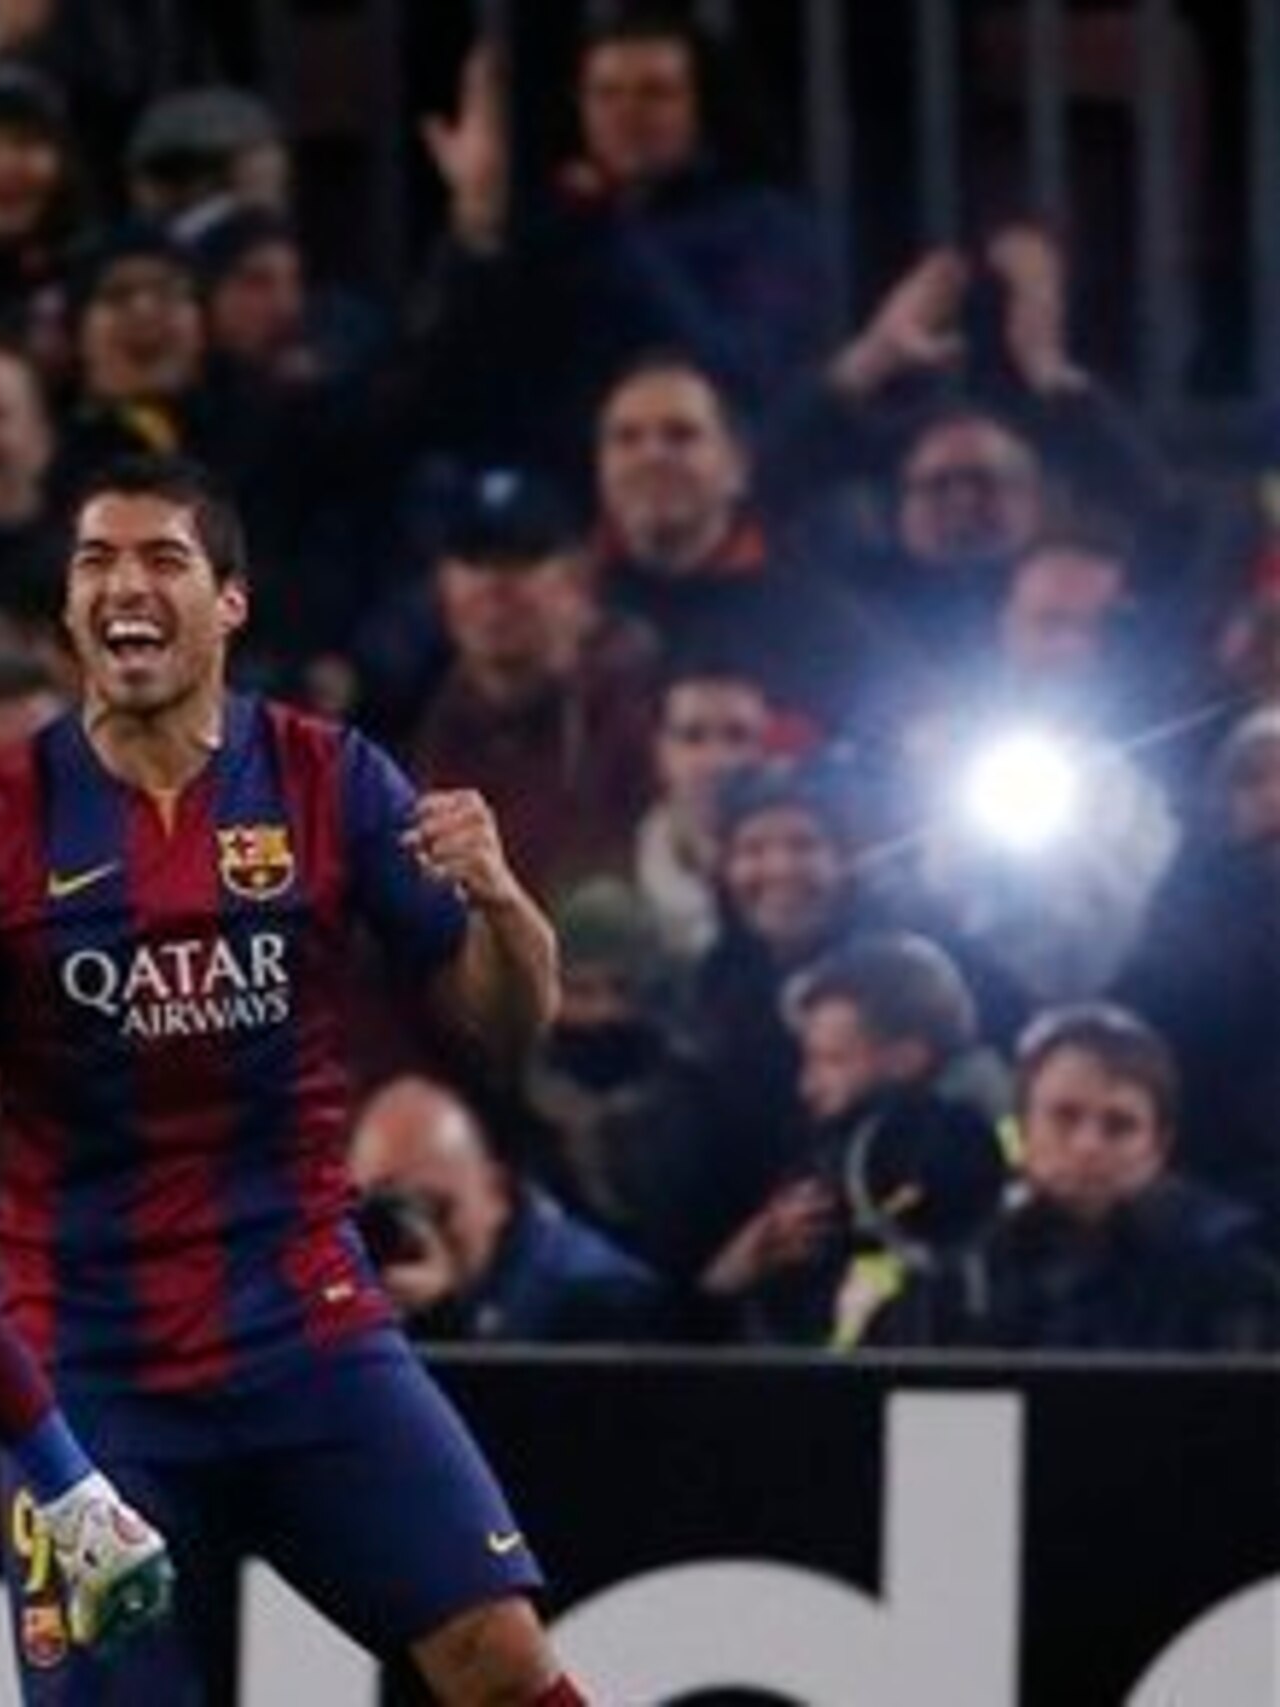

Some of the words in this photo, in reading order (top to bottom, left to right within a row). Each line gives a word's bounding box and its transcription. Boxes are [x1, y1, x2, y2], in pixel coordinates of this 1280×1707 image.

[62, 933, 289, 1015] QATAR
[121, 988, 290, 1037] AIRWAYS
[12, 1487, 51, 1591] 9
